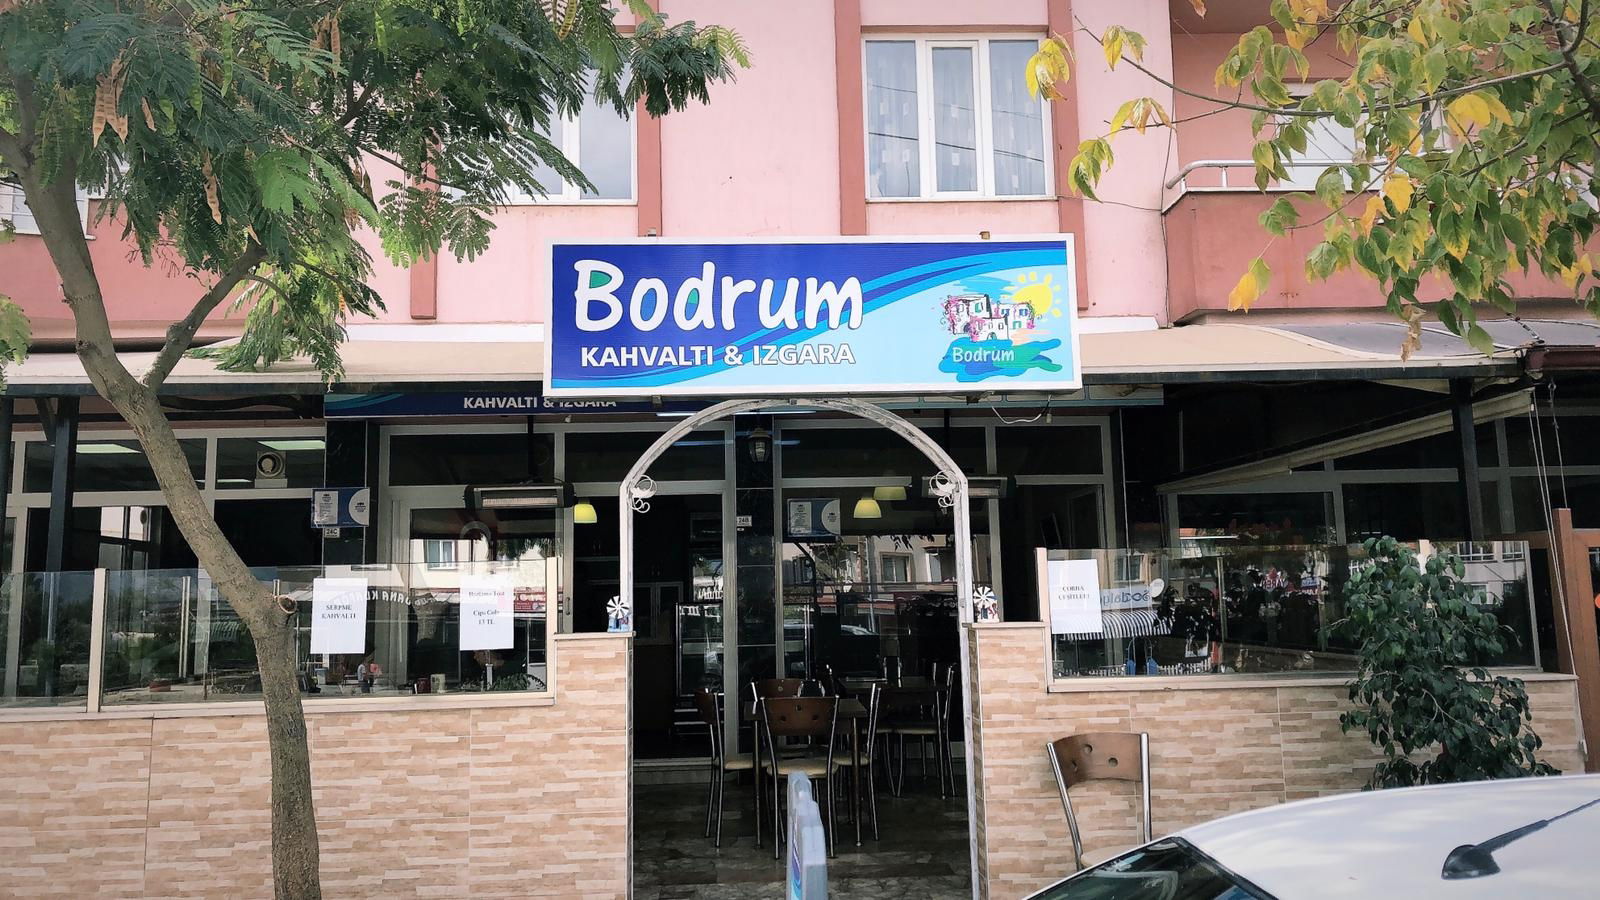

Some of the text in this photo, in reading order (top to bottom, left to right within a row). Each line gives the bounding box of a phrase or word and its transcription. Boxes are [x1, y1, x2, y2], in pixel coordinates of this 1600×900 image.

[574, 259, 864, 331] Bodrum
[581, 343, 856, 367] KAHVALTI & IZGARA
[952, 346, 1016, 363] Bodrum
[463, 397, 538, 409] KAHVALTI
[543, 396, 554, 408] &
